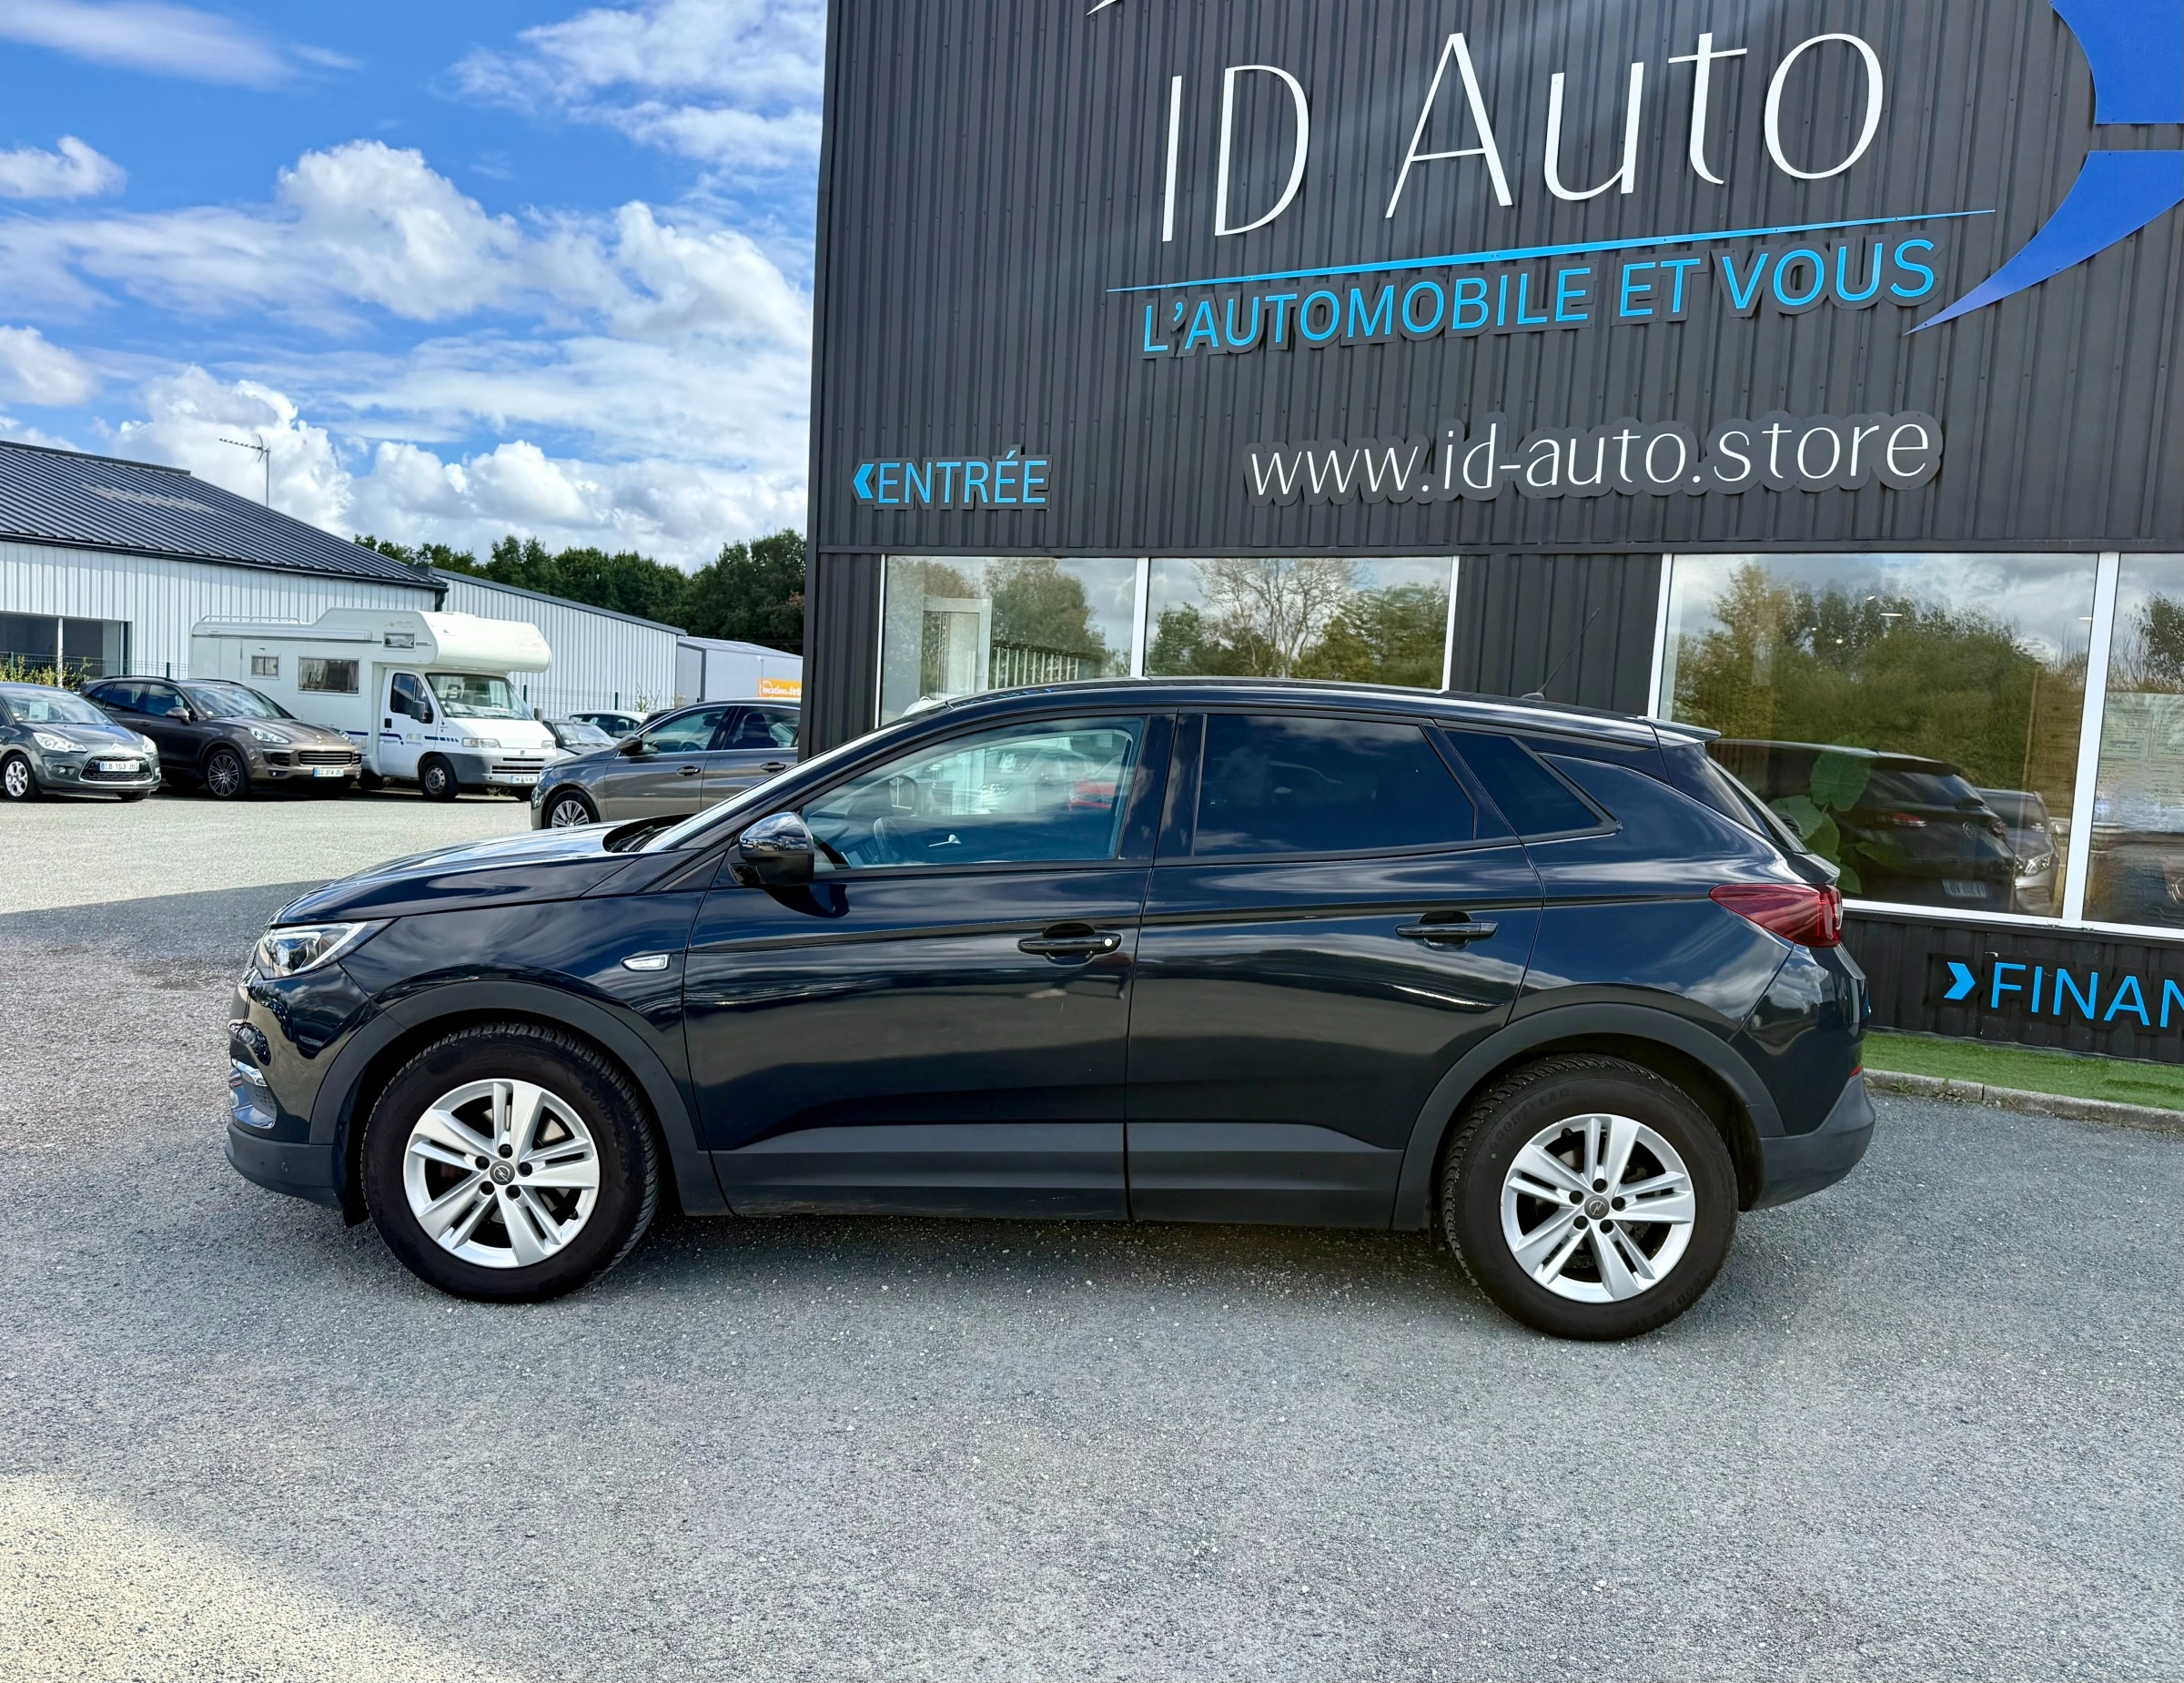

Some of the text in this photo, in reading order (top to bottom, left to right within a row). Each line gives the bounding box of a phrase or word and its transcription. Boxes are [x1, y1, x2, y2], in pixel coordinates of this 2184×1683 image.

[1385, 33, 1884, 218] Auto
[1143, 238, 1935, 352] L'AUTOMOBILE ET VOUS
[878, 451, 1048, 503] ENTRÉE
[1251, 422, 1928, 495] www.id-auto.store
